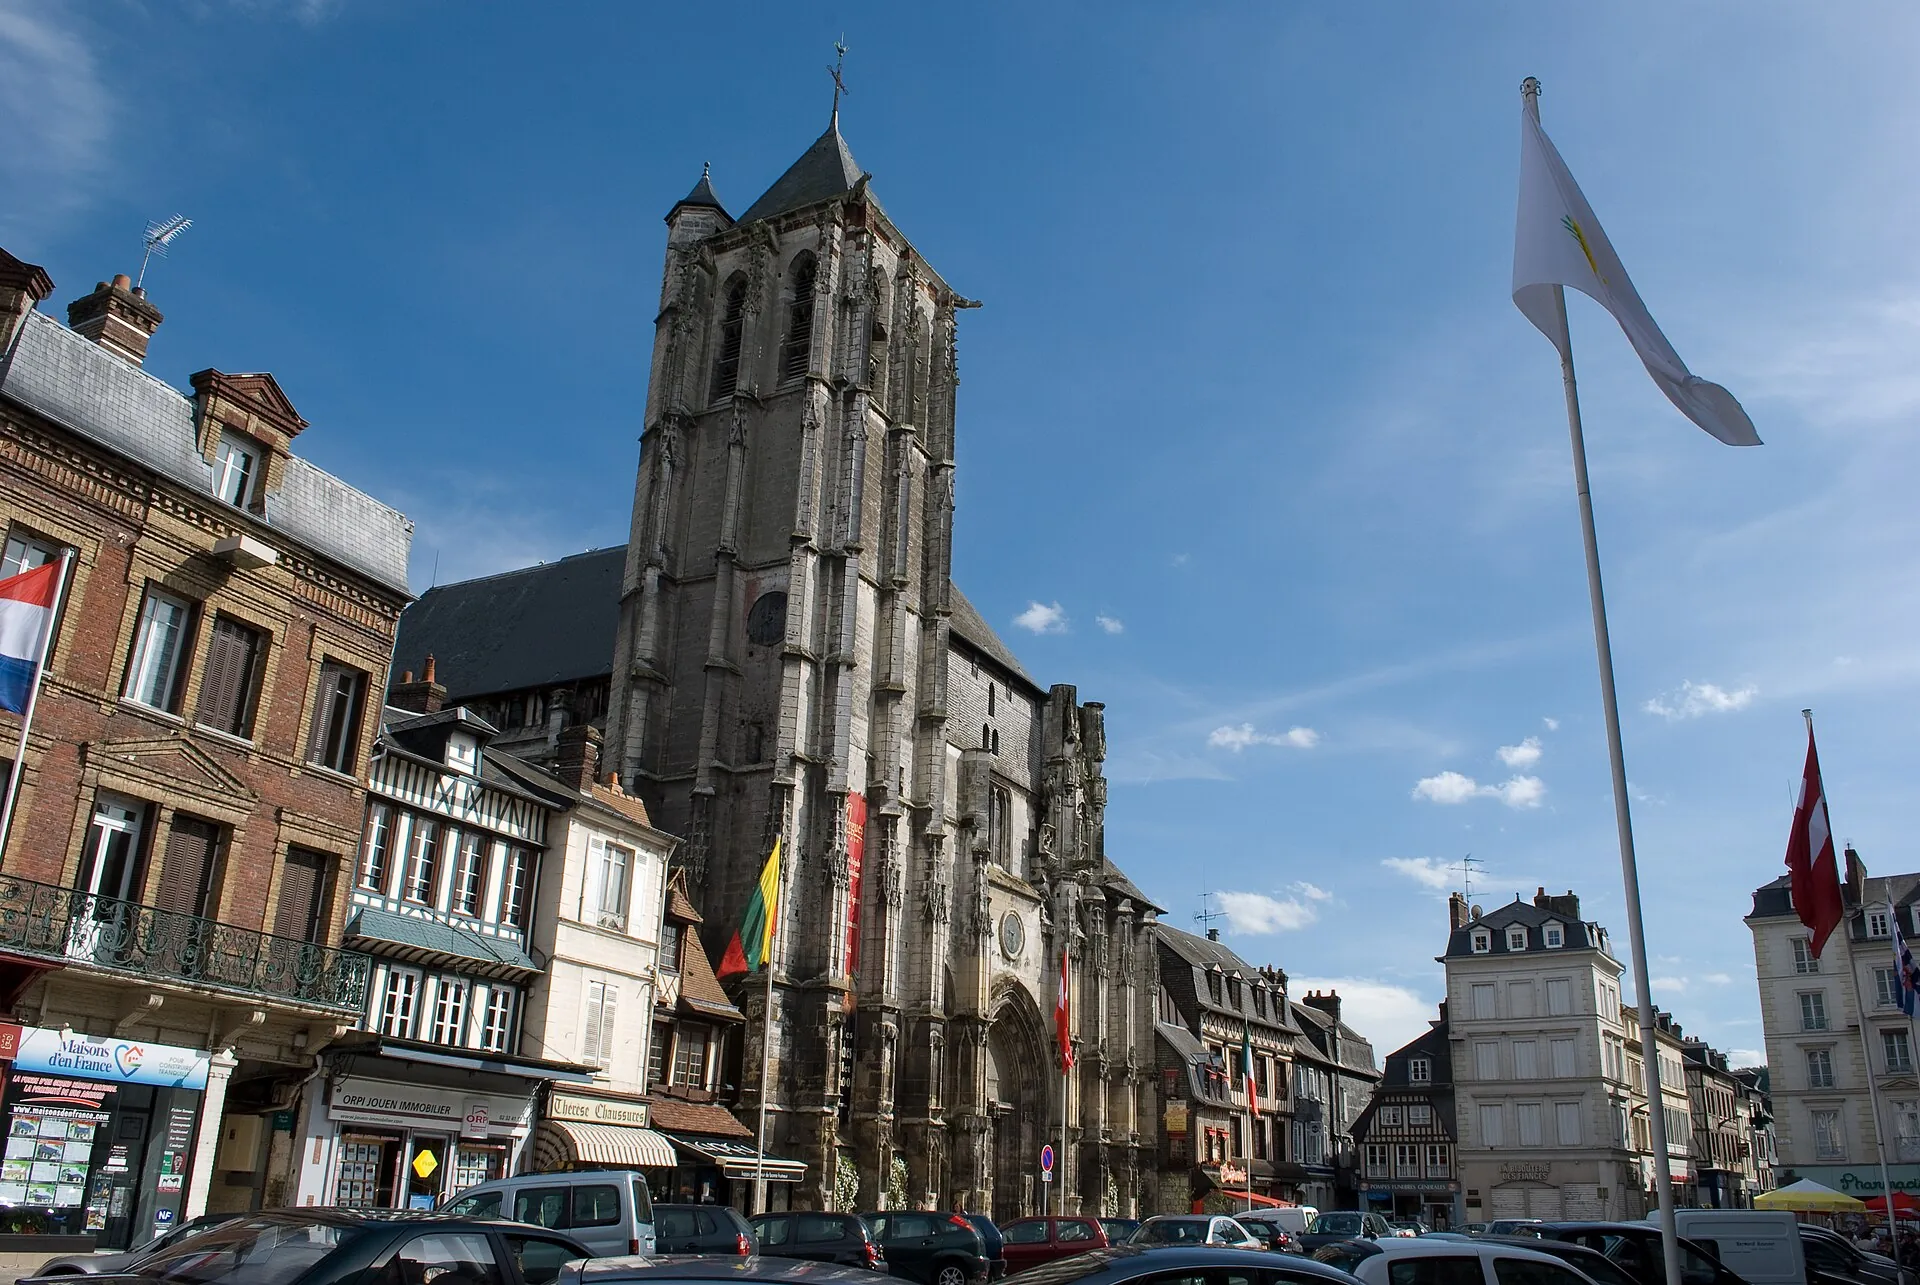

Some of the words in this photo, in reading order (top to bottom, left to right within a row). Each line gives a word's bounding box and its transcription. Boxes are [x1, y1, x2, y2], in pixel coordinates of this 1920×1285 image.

[59, 1039, 110, 1058] Maisons
[48, 1052, 73, 1067] d'en
[74, 1057, 113, 1073] France
[343, 1094, 366, 1106] ORPI
[366, 1097, 397, 1110] JOUEN
[399, 1101, 451, 1115] IMMOBILIER
[595, 1103, 644, 1123] Chaussures
[158, 1210, 172, 1220] NF
